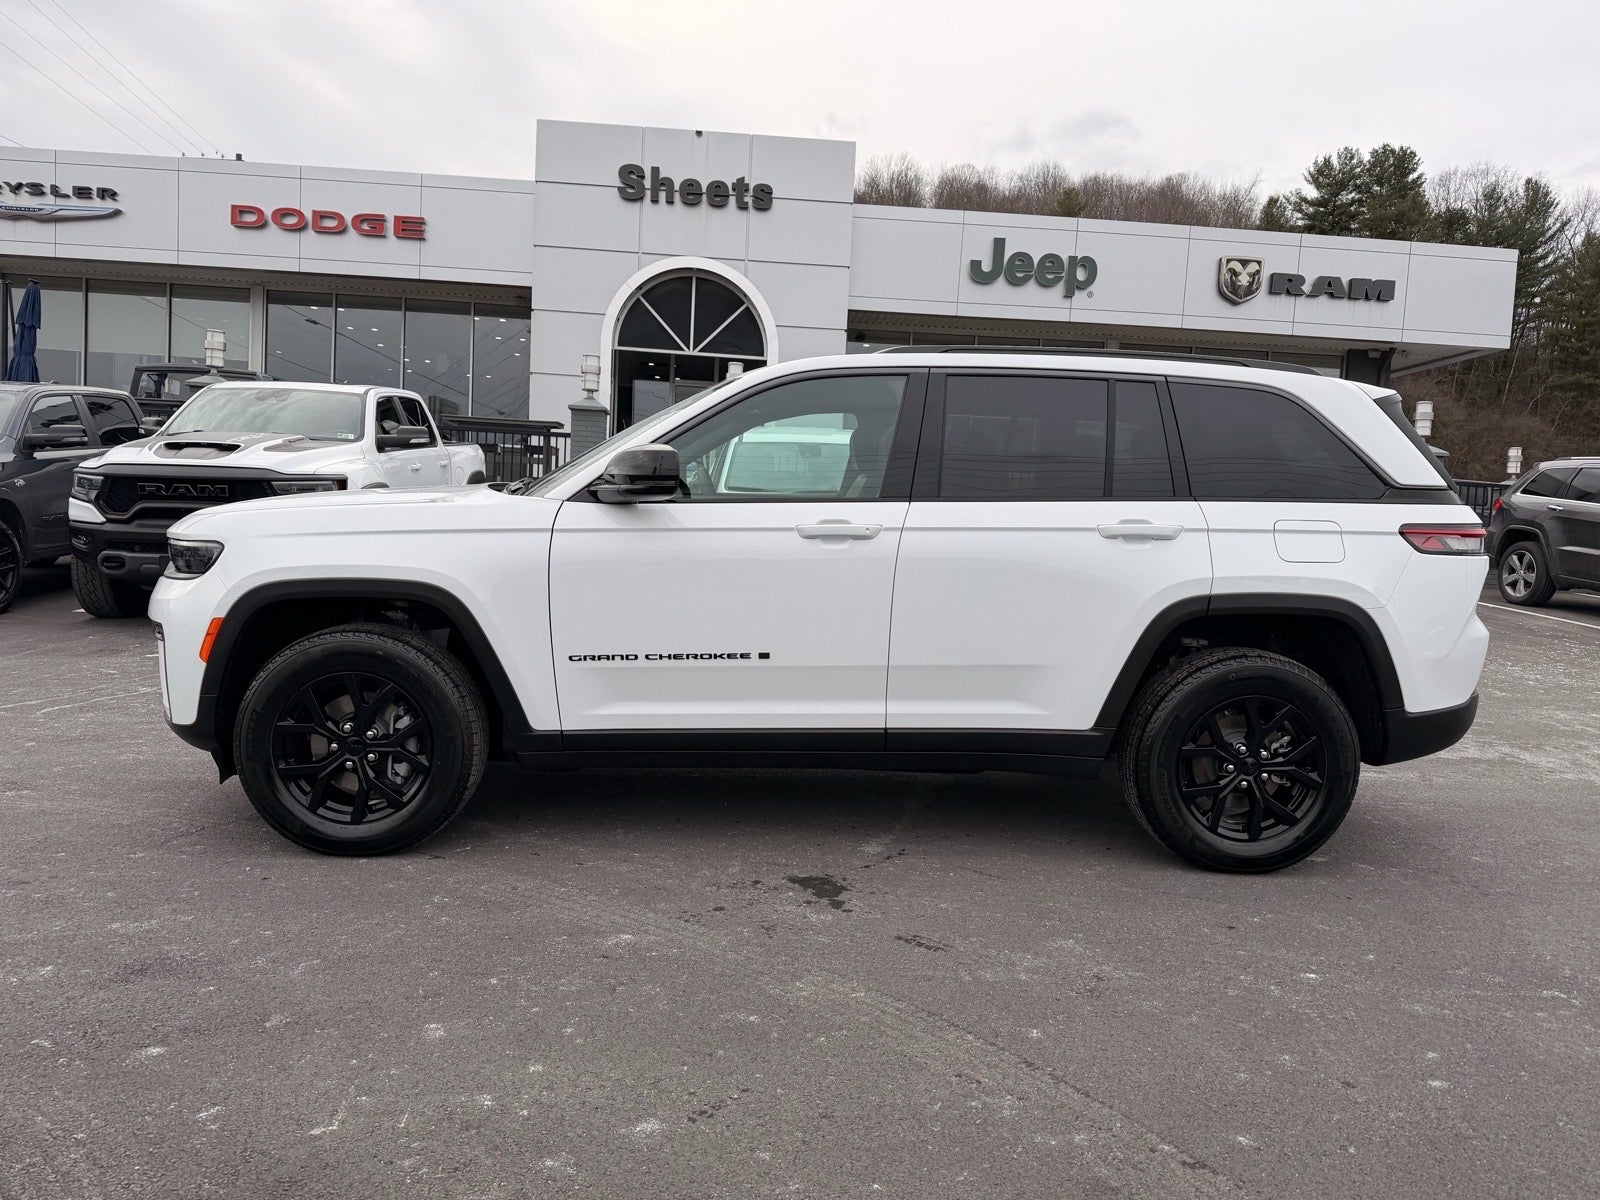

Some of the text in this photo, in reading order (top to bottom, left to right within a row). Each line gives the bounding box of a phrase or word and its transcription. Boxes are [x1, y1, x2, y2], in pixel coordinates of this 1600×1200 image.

[0, 181, 119, 202] YSLER
[617, 163, 773, 210] Sheets
[230, 204, 426, 240] DODGE
[969, 236, 1098, 298] Jeep
[1269, 272, 1396, 301] RAM
[137, 482, 229, 497] RAM
[568, 652, 752, 662] GRAND CHEROKEE
